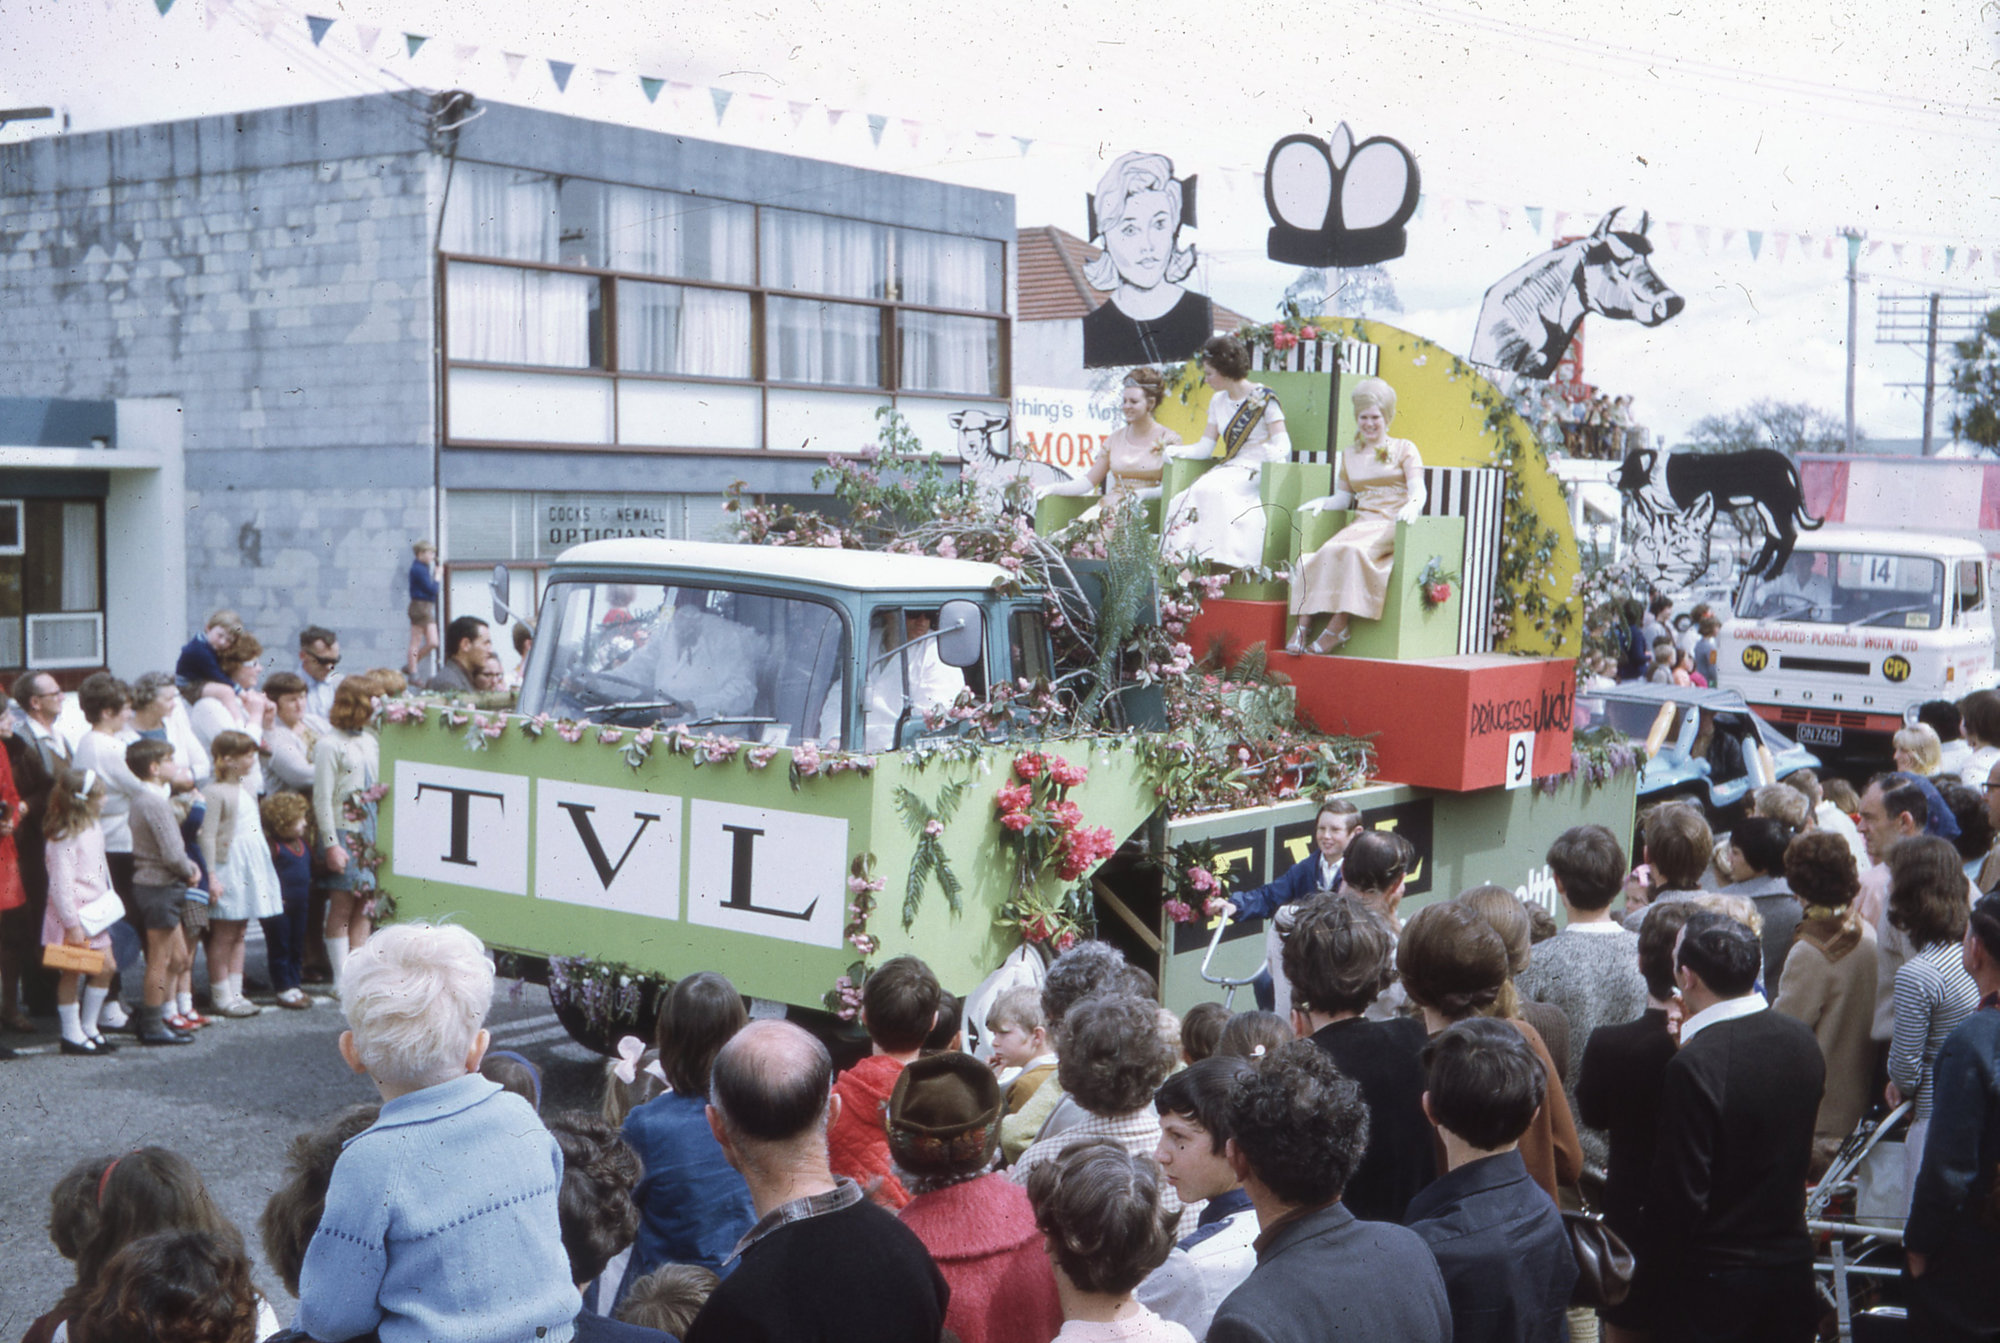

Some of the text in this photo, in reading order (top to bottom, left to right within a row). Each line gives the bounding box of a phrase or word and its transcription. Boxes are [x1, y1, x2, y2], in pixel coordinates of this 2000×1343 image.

[1026, 431, 1109, 467] MOR
[549, 506, 590, 522] COCKS
[617, 507, 665, 522] NEWALL
[1870, 558, 1891, 583] 14
[1733, 628, 1806, 644] CONSOLIDATED
[1811, 632, 1857, 648] PLASTICS
[1743, 647, 1766, 670] CPI
[1884, 657, 1908, 680] CPI
[1774, 688, 1874, 705] FORD
[1514, 739, 1526, 782] 9
